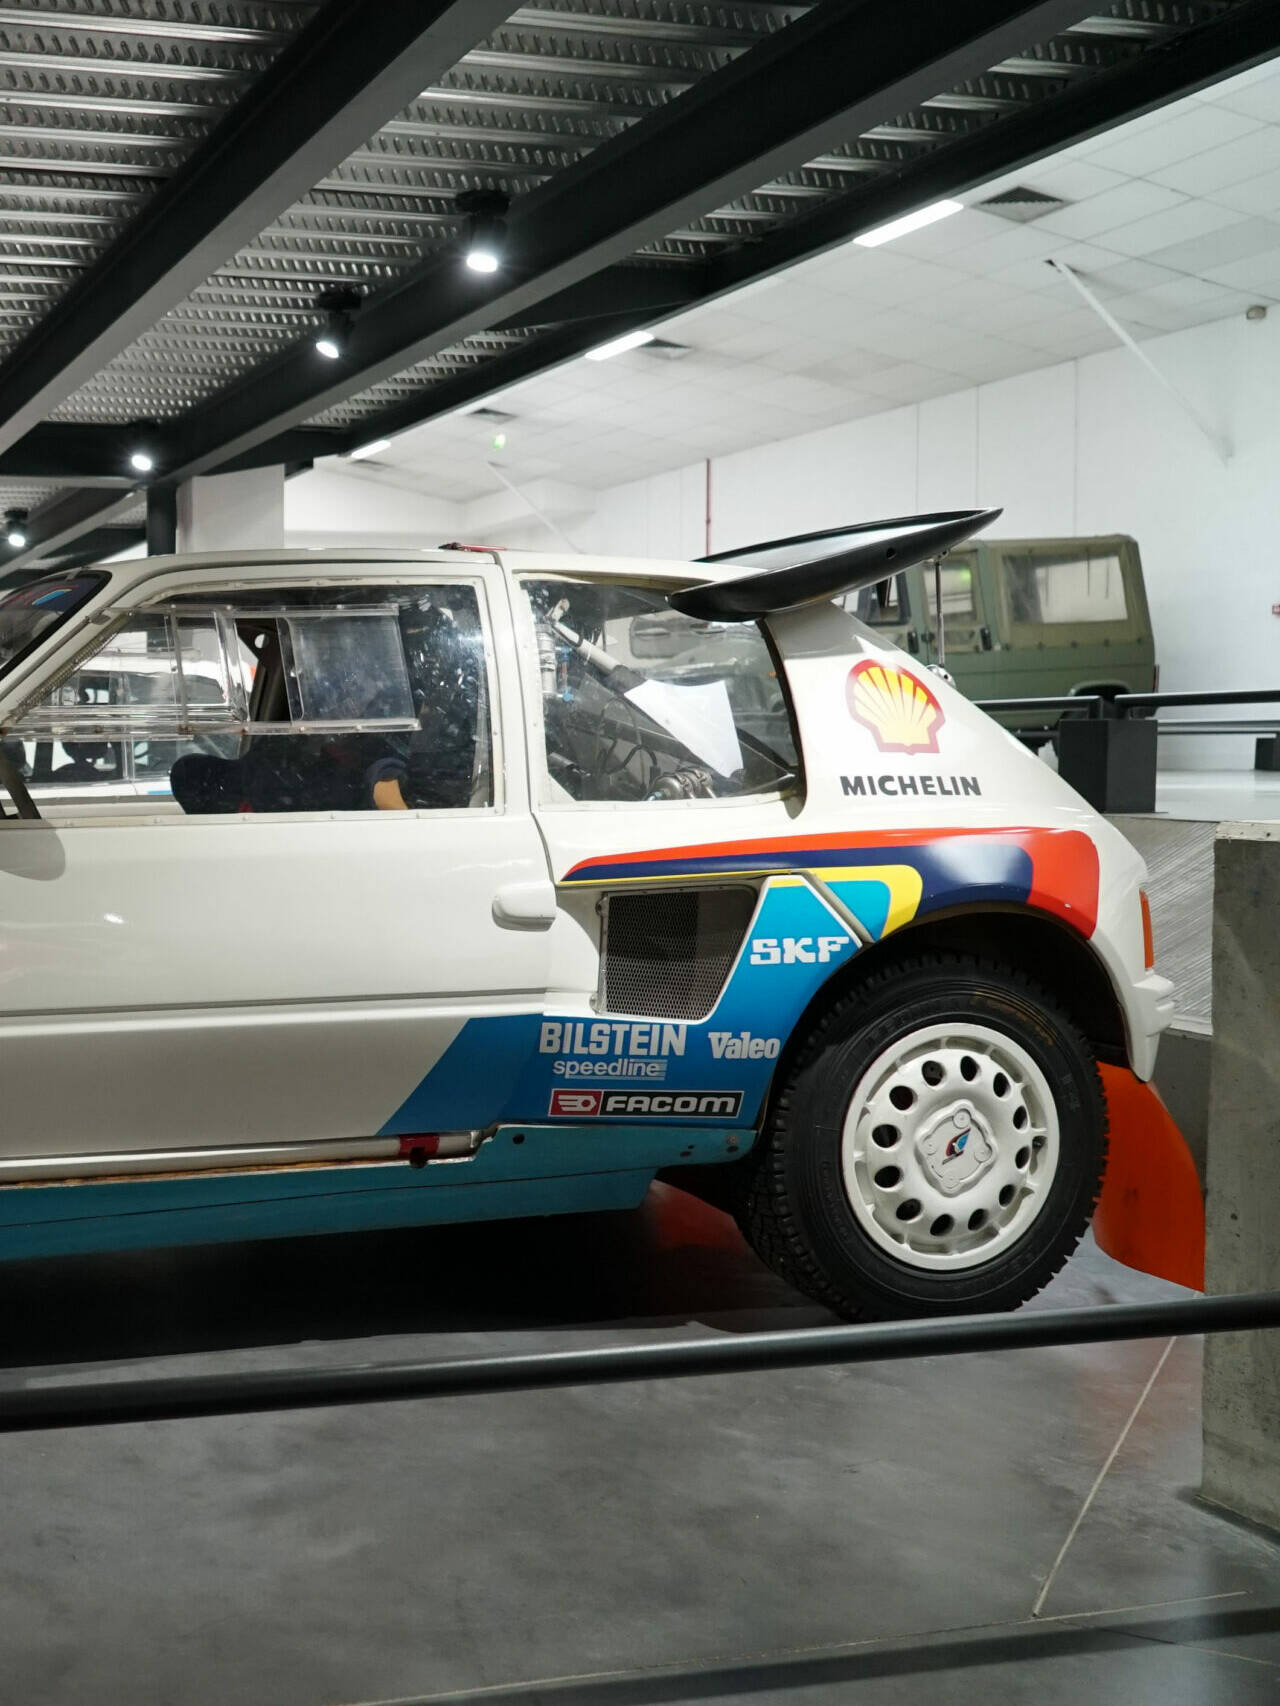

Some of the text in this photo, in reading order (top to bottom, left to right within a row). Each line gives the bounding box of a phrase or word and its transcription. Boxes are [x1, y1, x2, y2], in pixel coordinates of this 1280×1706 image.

[839, 775, 982, 796] MICHELIN
[750, 936, 850, 965] SKF
[538, 1022, 687, 1056] BILSTEIN
[708, 1031, 781, 1059] Valeo
[552, 1058, 665, 1080] speedline
[605, 1096, 736, 1113] FACOM
